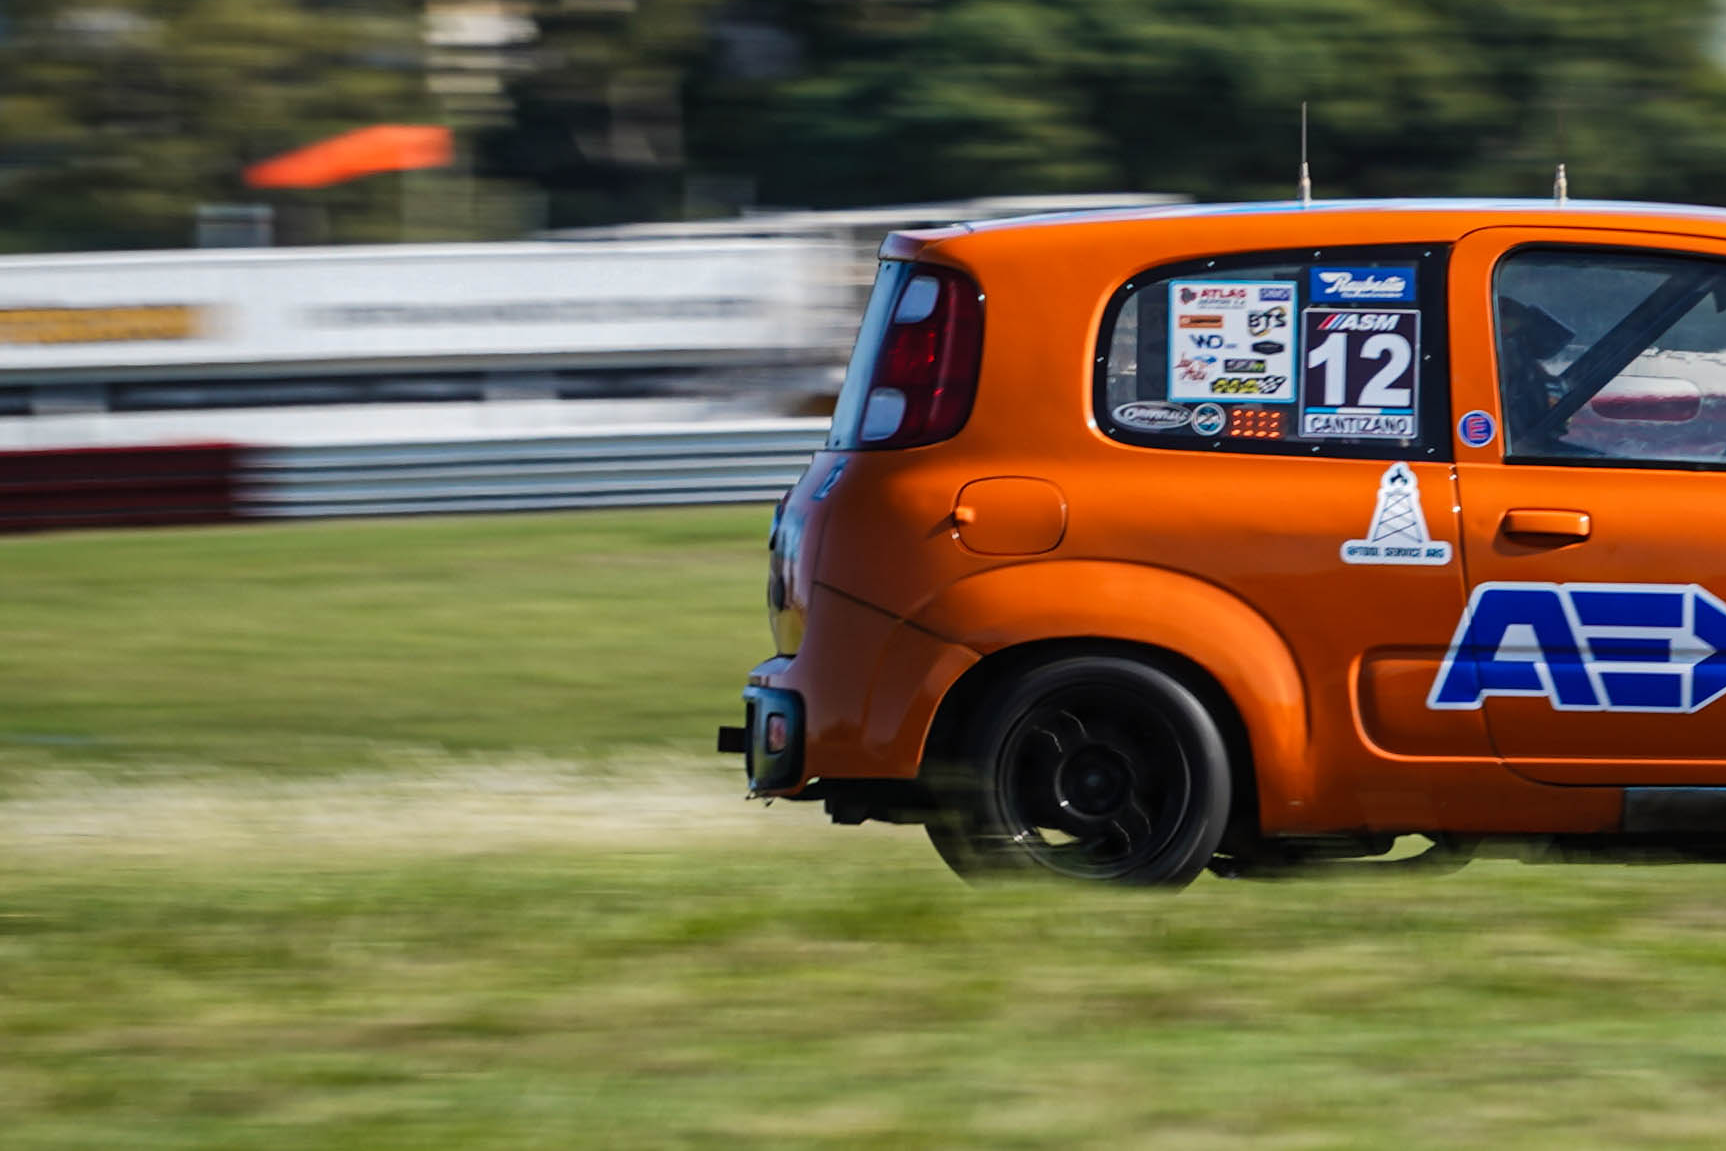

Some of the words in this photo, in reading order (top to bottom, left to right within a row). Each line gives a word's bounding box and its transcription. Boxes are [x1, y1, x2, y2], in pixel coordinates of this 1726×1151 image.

[1200, 288, 1247, 299] ATLAS
[1338, 313, 1402, 331] ASM
[1307, 332, 1412, 406] 12
[1310, 416, 1408, 433] CANTIZANO
